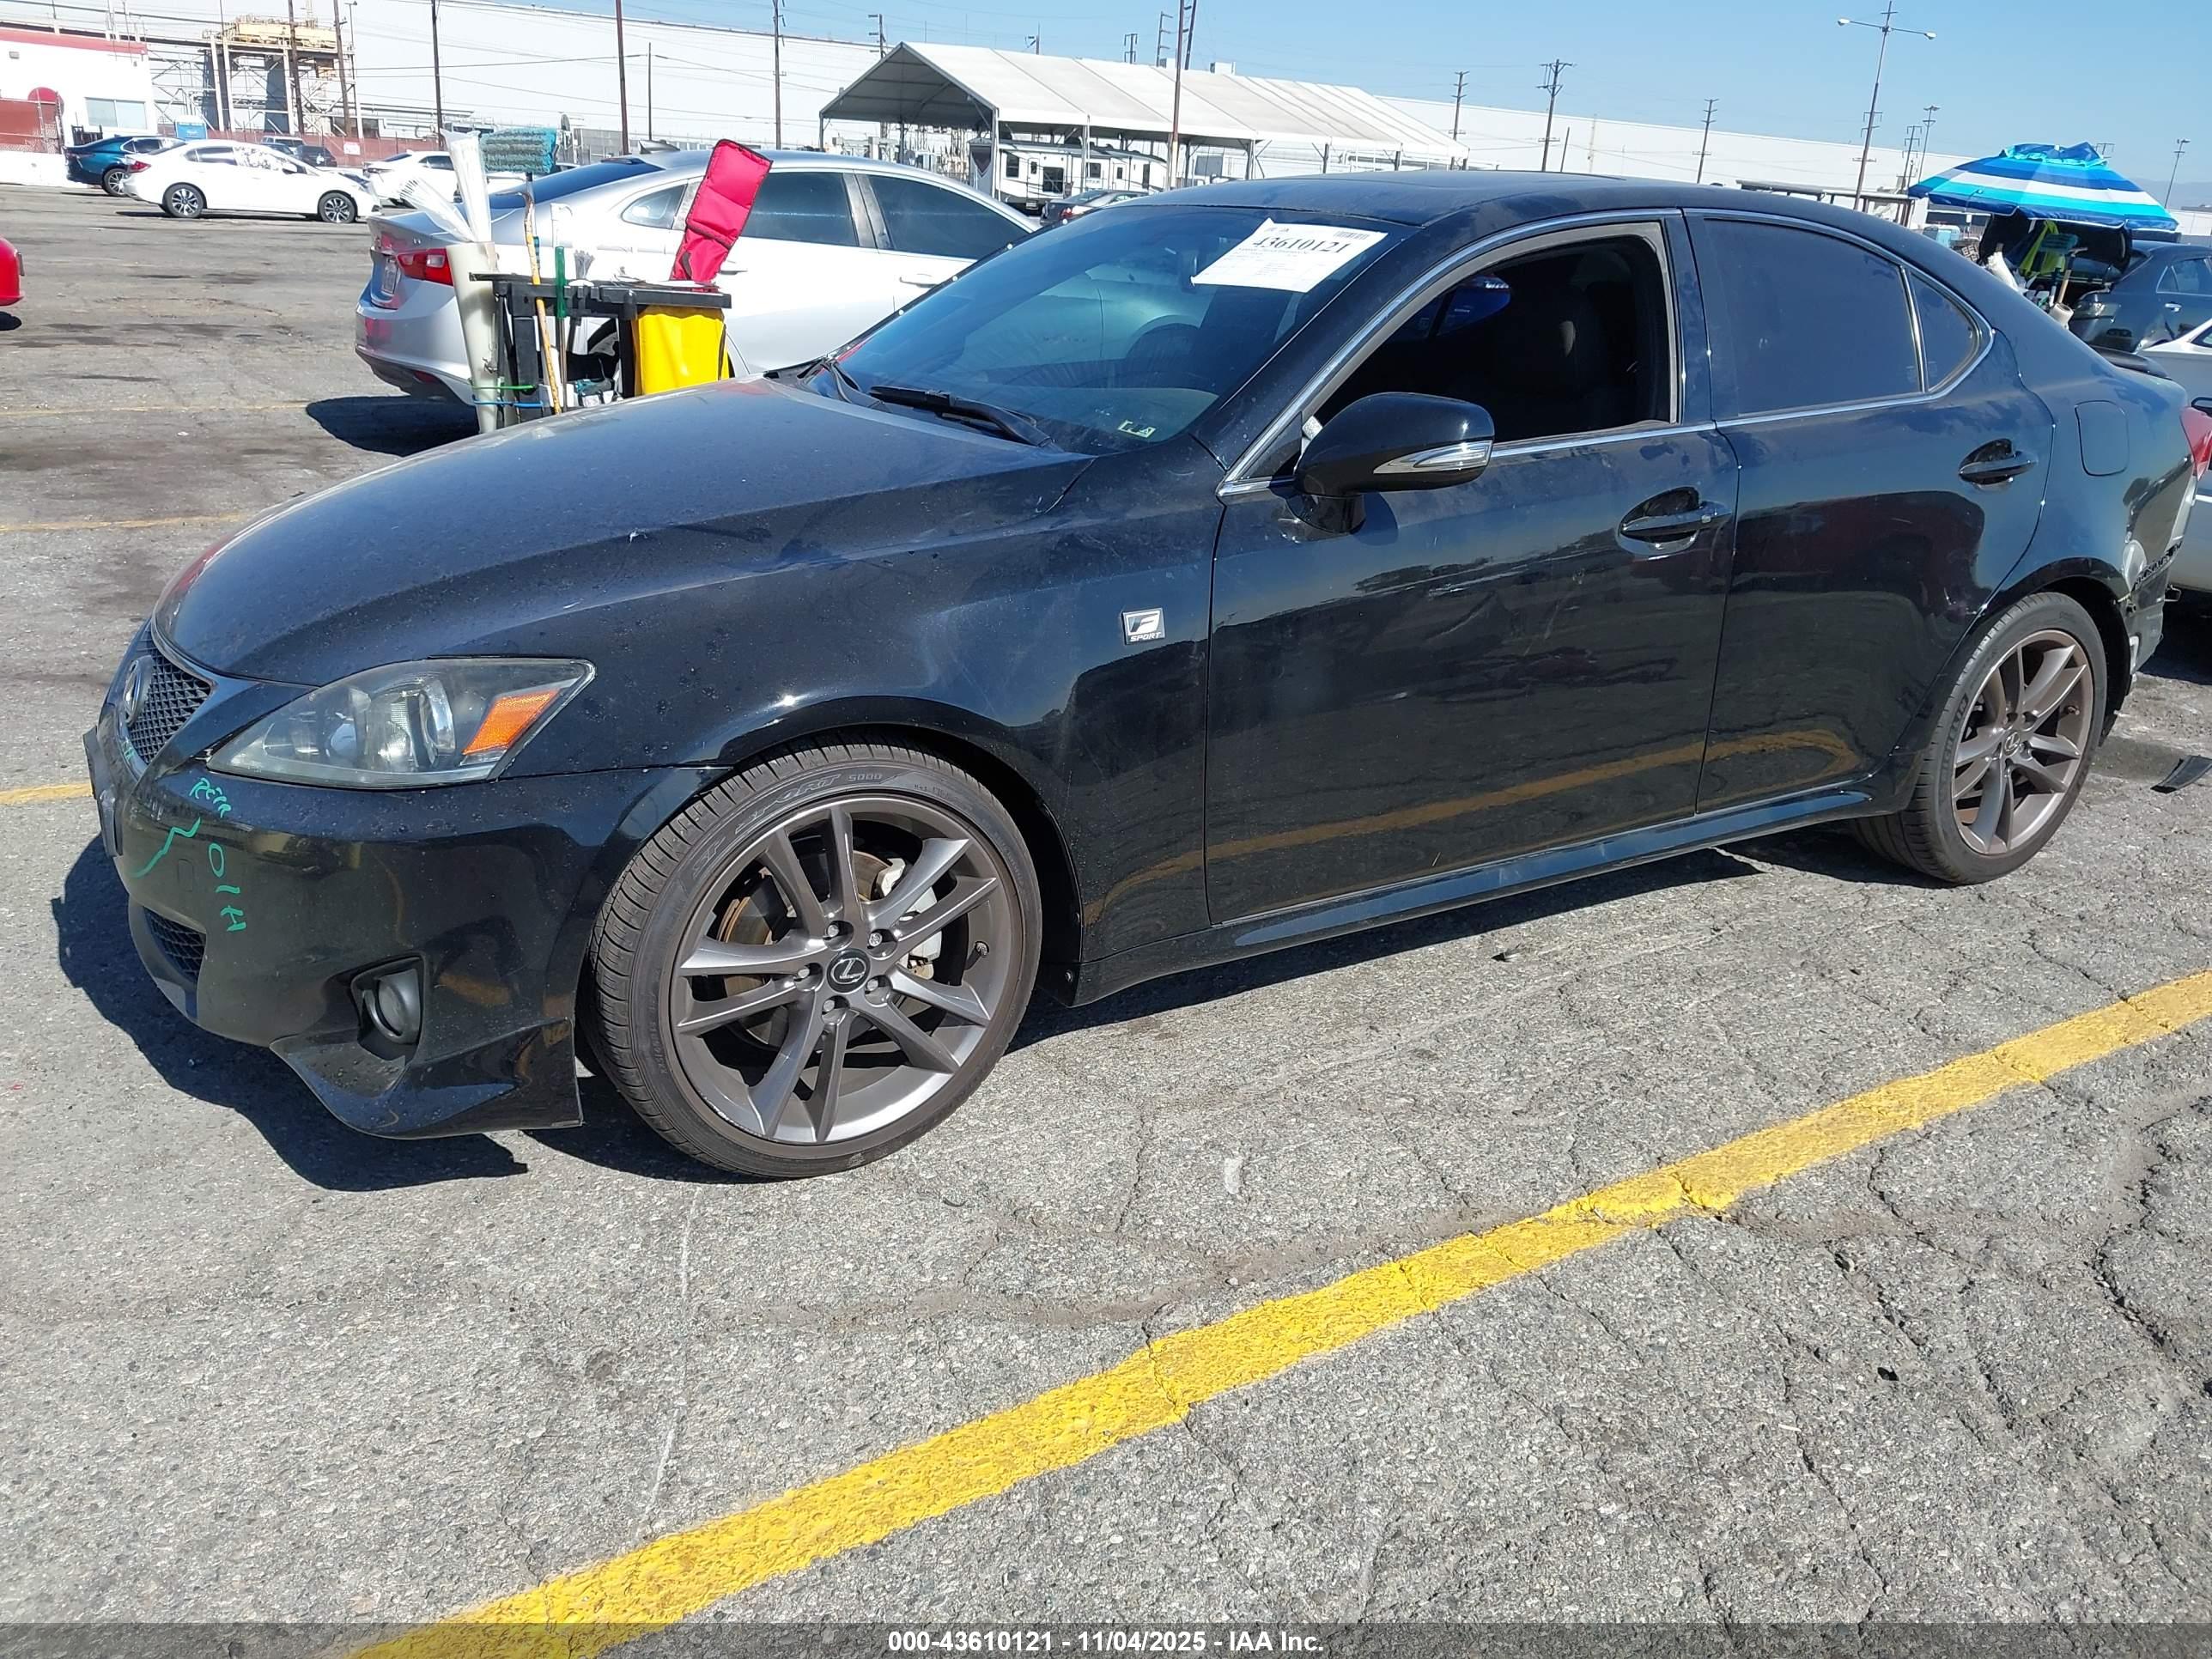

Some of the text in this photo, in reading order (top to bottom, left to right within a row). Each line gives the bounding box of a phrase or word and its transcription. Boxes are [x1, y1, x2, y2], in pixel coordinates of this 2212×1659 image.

[1253, 237, 1352, 253] 43610121
[1129, 632, 1161, 641] SPORT
[848, 774, 884, 782] 5000
